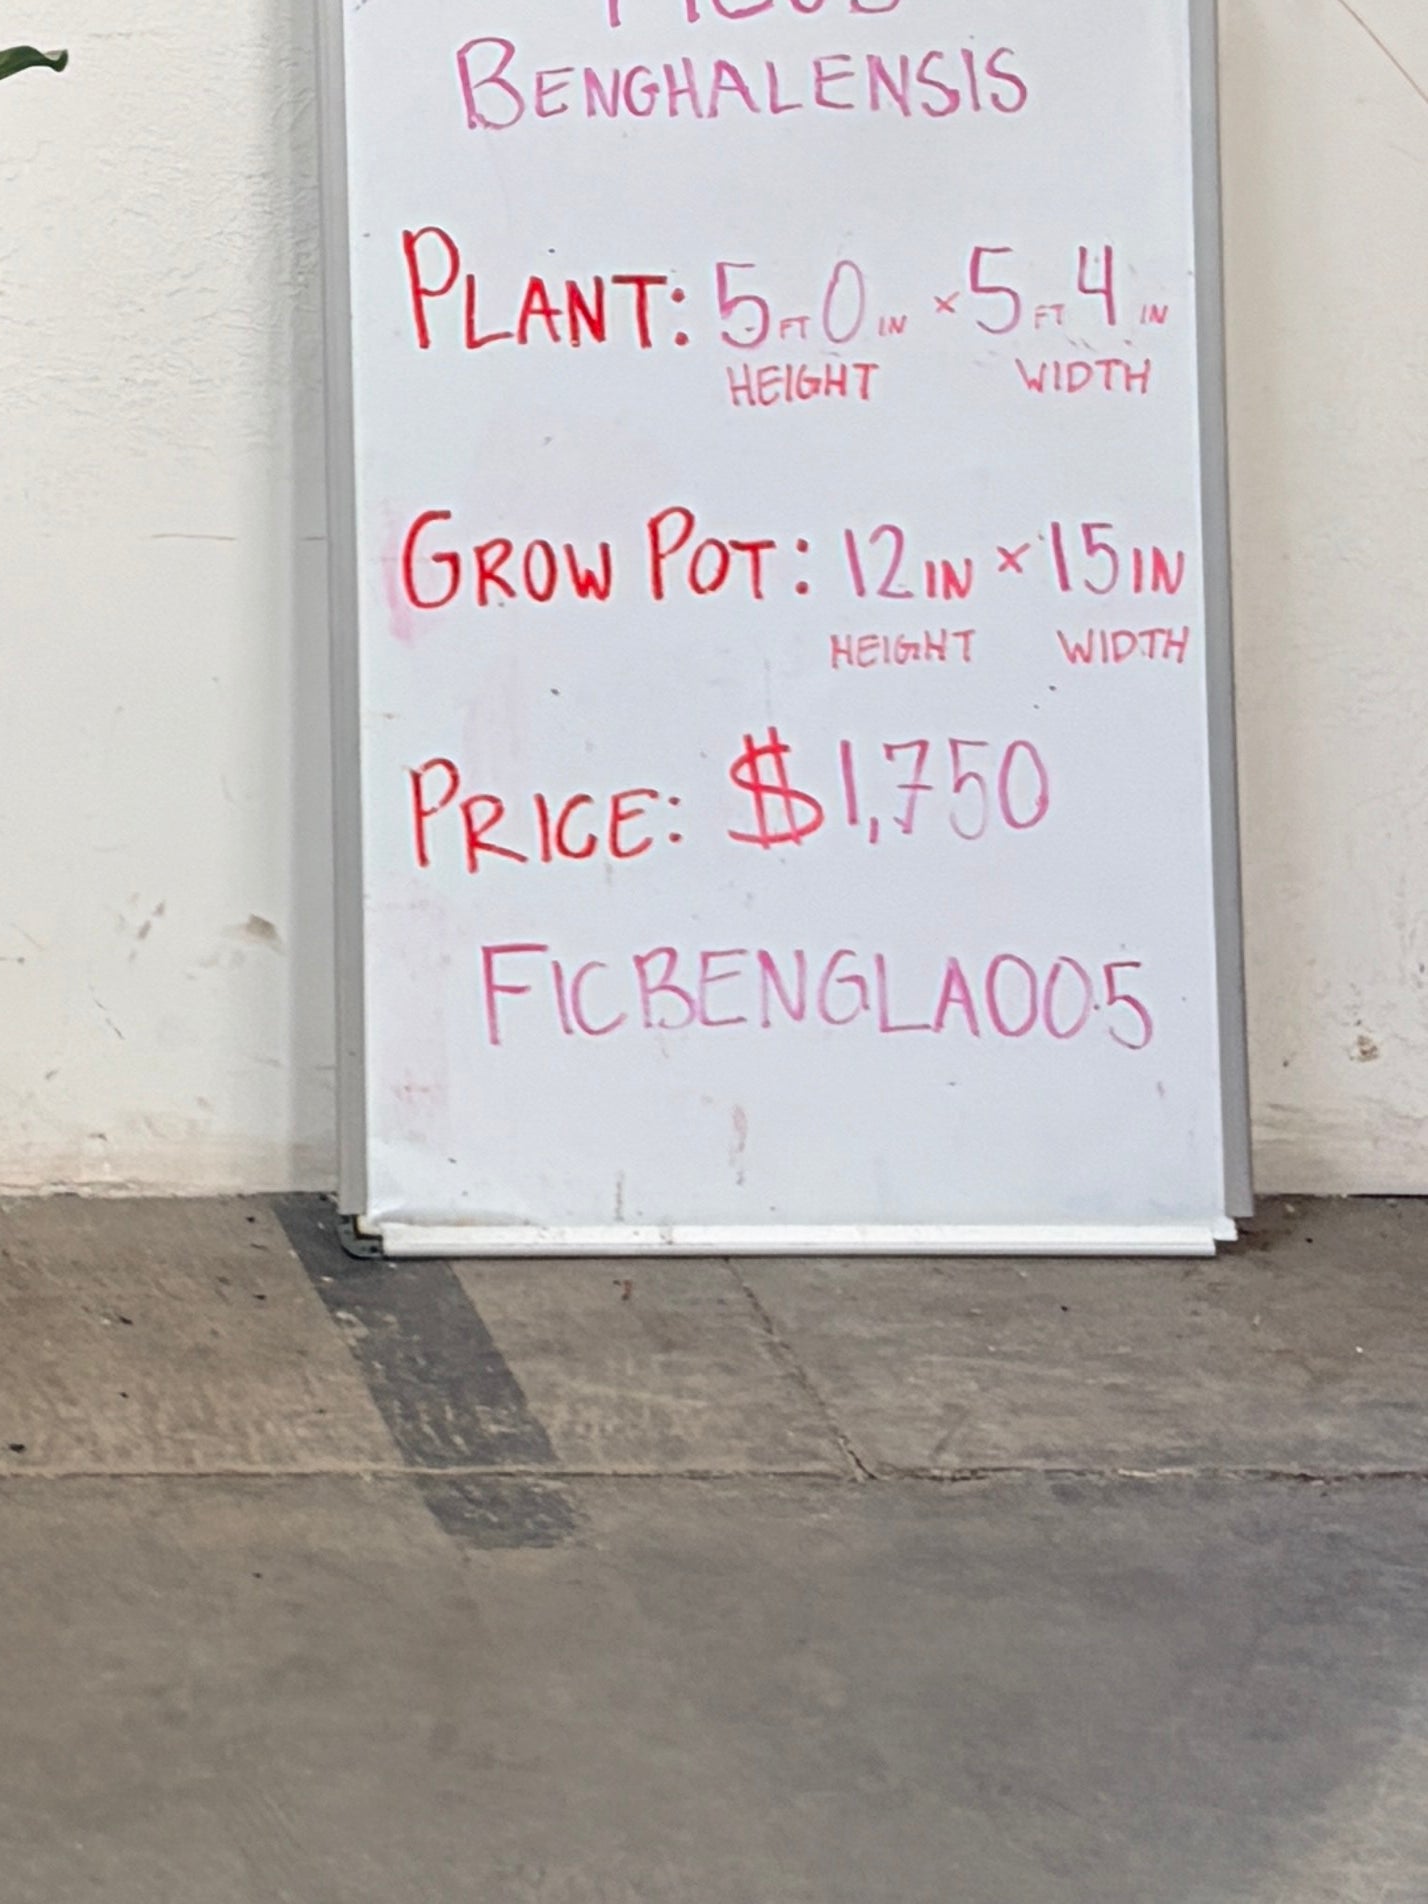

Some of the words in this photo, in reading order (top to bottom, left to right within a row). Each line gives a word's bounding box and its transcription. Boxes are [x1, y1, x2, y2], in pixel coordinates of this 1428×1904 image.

[455, 35, 1029, 131] BENGHALENSIS
[400, 225, 690, 350] PLANT:
[726, 361, 881, 408] HEIGHT
[1015, 357, 1152, 395] WIDTH
[400, 507, 612, 611] GROW
[647, 504, 813, 602] POT:
[829, 627, 977, 671] HEIGHT
[1056, 626, 1190, 667] WIDTH
[408, 756, 684, 874] PRICE:
[726, 725, 1052, 850] $1,750
[480, 942, 1155, 1052] FICBENGLA005
